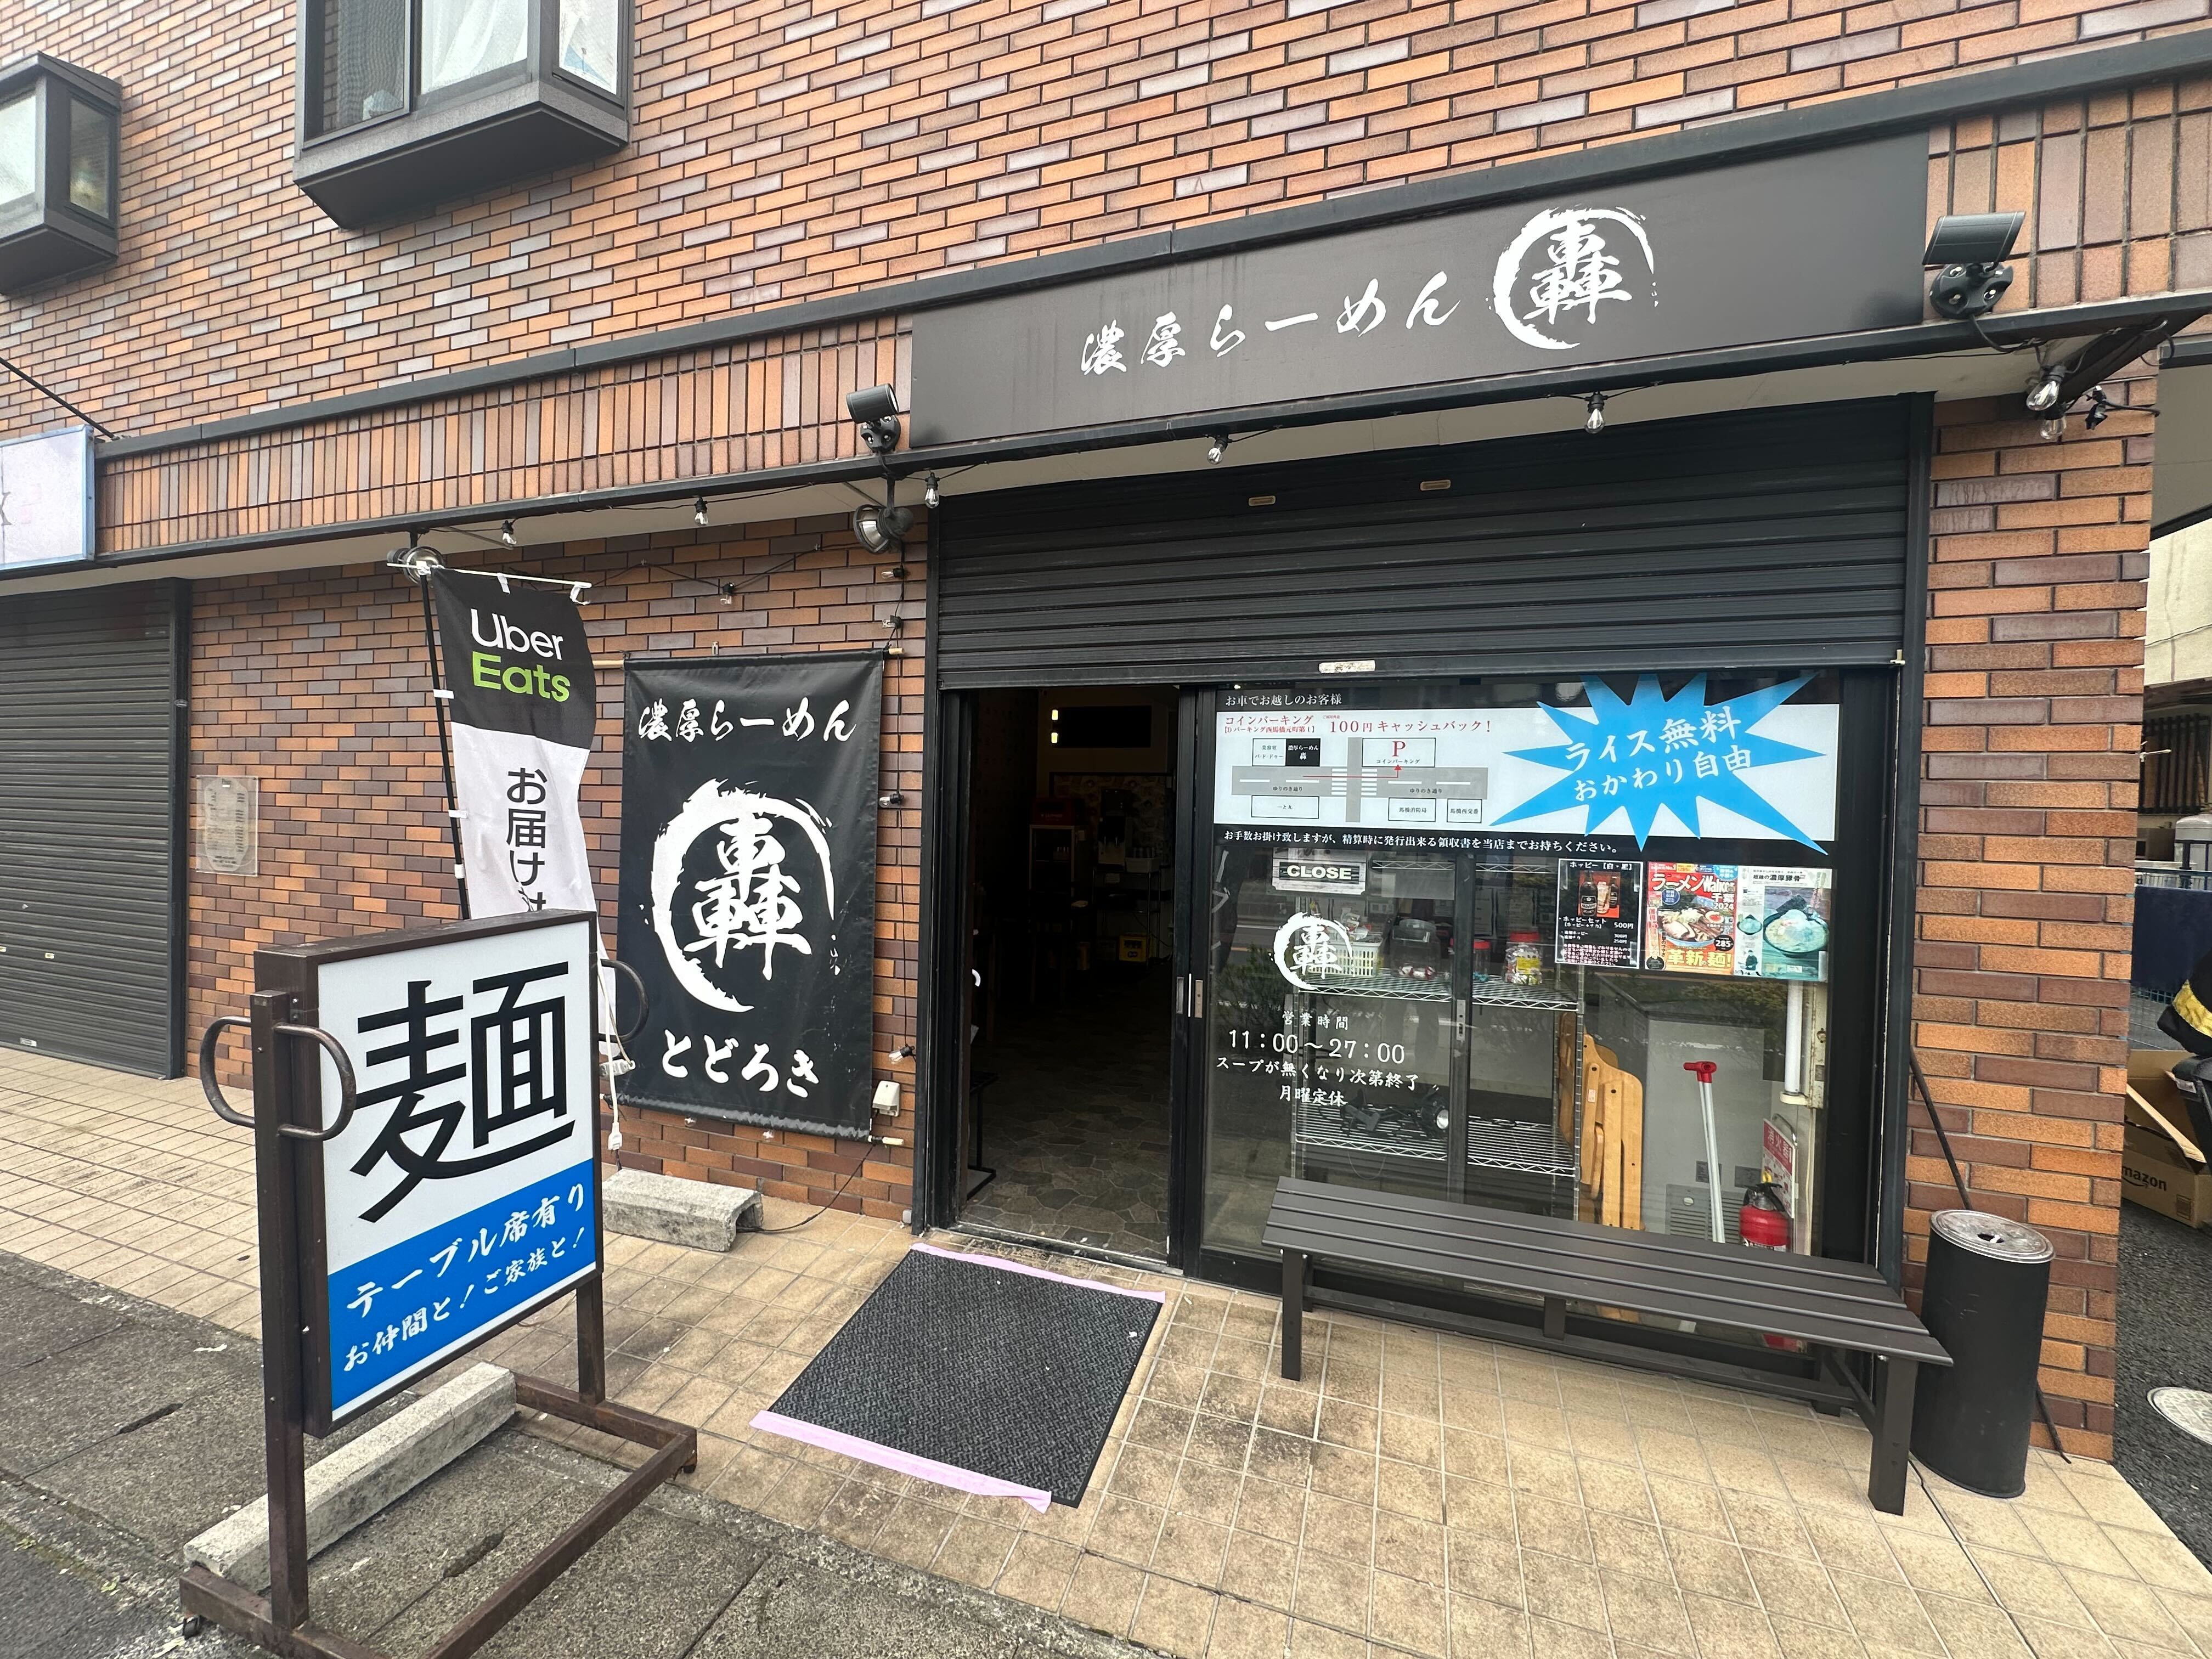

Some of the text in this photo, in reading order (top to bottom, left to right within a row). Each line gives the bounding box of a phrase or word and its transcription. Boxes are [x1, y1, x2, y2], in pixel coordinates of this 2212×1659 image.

[1081, 219, 1632, 376] 濃厚らーめん 轟
[471, 608, 563, 660] Uber
[472, 651, 571, 702] Eats
[1225, 693, 1342, 706] お車でお越しのお客様
[638, 697, 857, 742] 濃厚らーめん
[1226, 715, 1314, 726] コインパーキング
[1566, 705, 1741, 772] ライス無料
[1392, 741, 1406, 757] P
[1574, 744, 1752, 801] おかわり自由
[684, 813, 812, 980] 轟
[1286, 865, 1352, 880] CLOSE
[1711, 893, 1734, 903] 千葉
[1290, 924, 1343, 980] 轟
[1282, 1010, 1348, 1031] 営業時間
[661, 1029, 819, 1097] とどろき
[1216, 1056, 1420, 1092] スープが無くなり次第終了
[349, 961, 575, 1223] 麺
[1279, 1085, 1348, 1107] 月曜定休
[2122, 1165, 2166, 1192] mazon
[346, 1183, 585, 1319] テーブル席有り
[343, 1227, 585, 1373] お仲間と!ご家族と!
